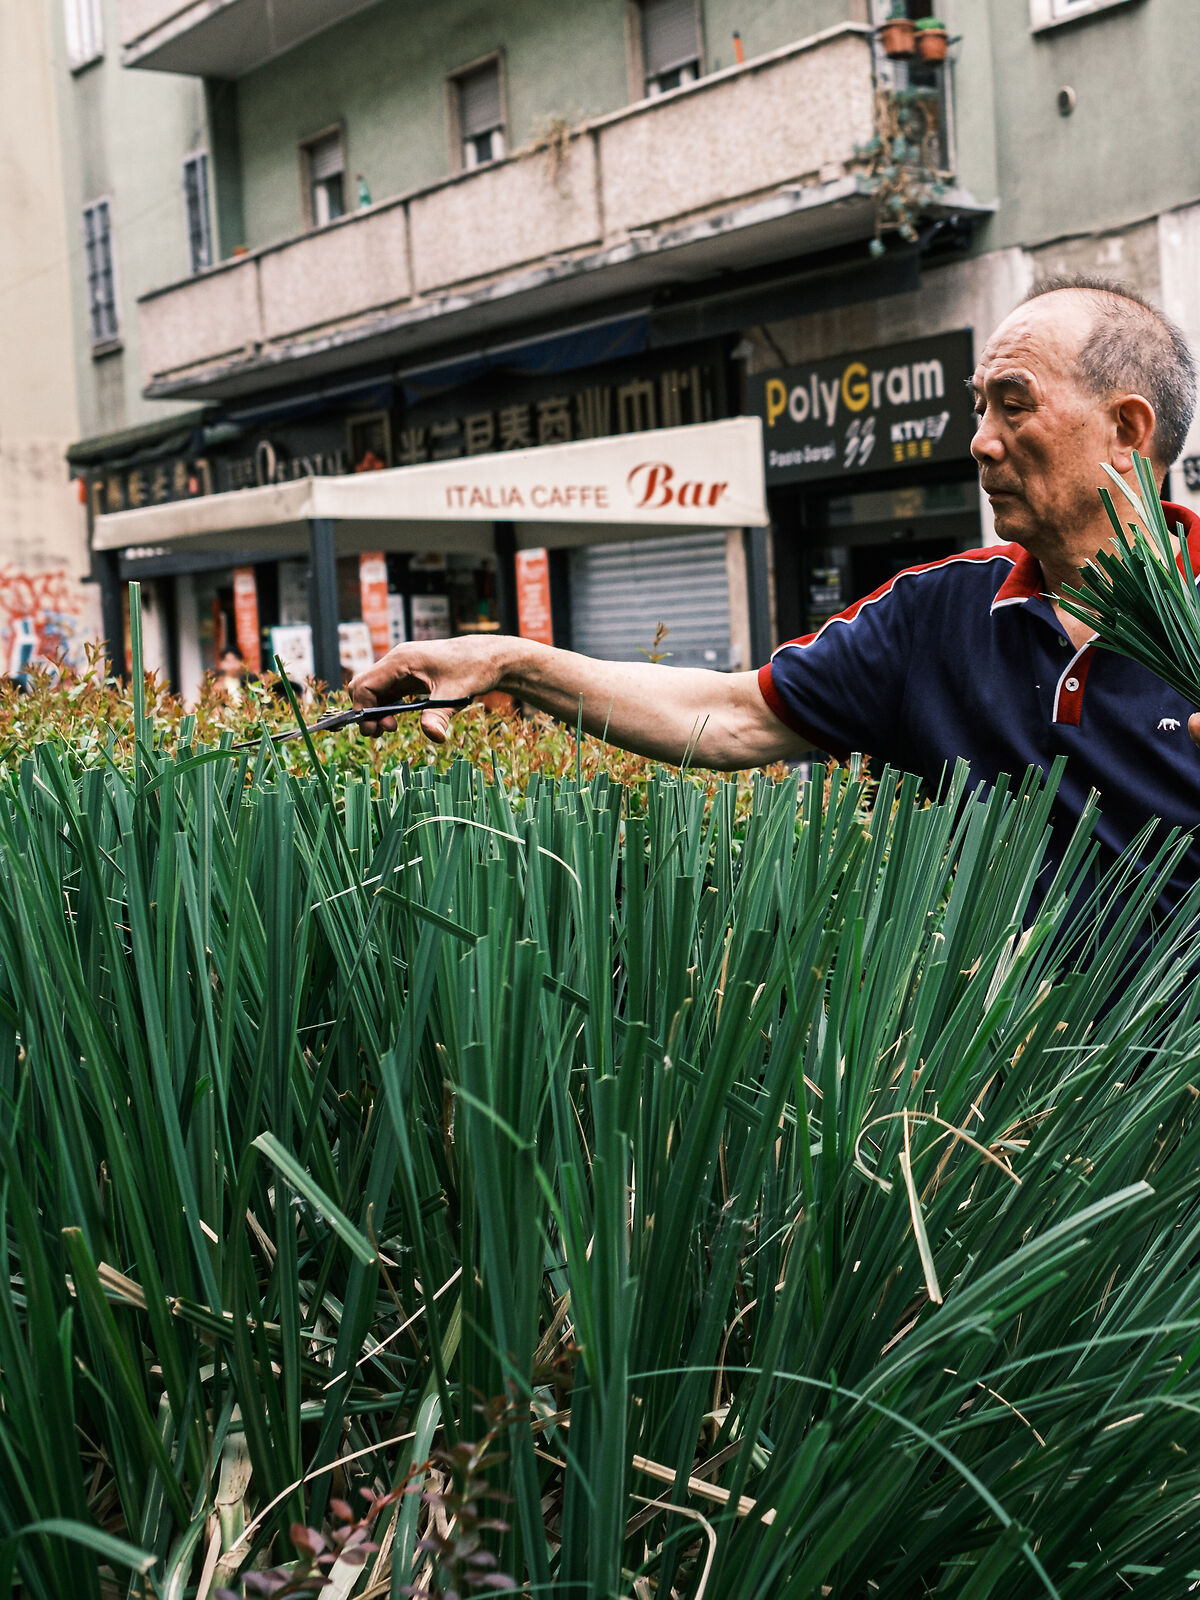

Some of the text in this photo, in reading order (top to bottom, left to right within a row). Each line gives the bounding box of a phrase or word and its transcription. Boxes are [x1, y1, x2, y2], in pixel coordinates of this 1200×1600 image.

[765, 358, 946, 428] PolyGram
[890, 418, 926, 443] KTV
[446, 460, 731, 509] ITALIA CAFFE Bar
